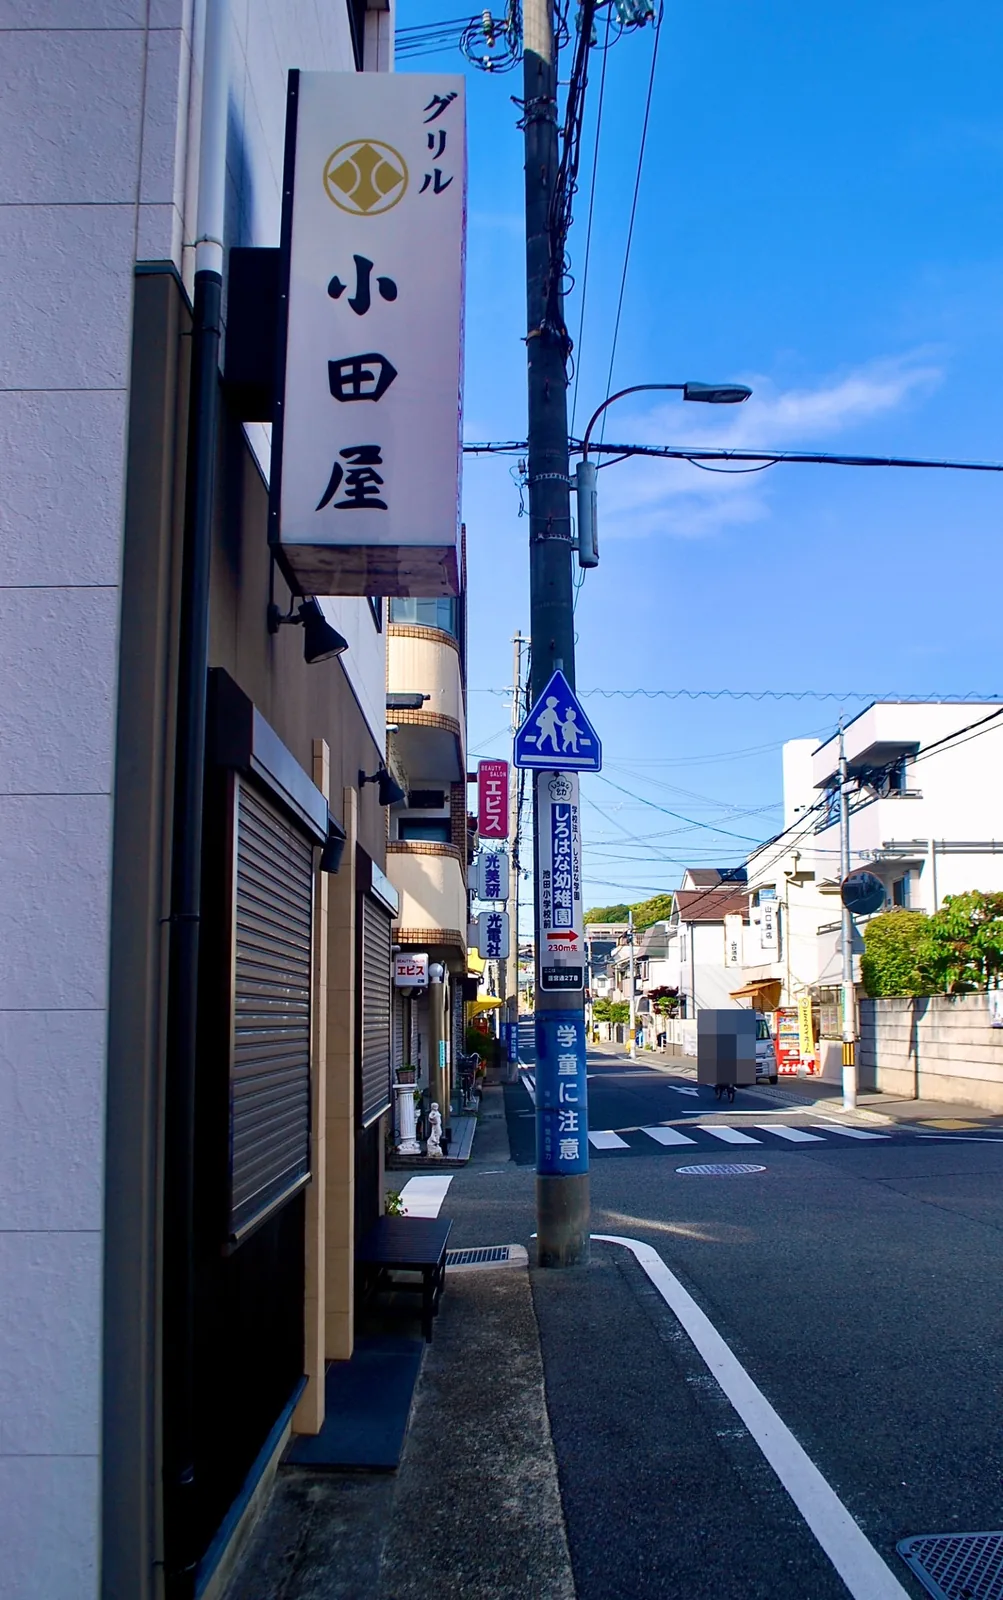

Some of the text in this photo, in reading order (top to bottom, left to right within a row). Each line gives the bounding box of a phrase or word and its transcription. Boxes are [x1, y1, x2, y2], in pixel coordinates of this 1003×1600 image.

[418, 91, 458, 195] グリル
[314, 253, 398, 512] 小田屋
[485, 780, 502, 831] エビス
[485, 854, 501, 898] 光美研
[553, 805, 572, 926] しろはな幼稚園
[543, 870, 552, 929] 池田小学校前
[486, 913, 503, 957] 光電社
[548, 944, 578, 952] 230m先
[397, 965, 425, 976] エビス
[557, 1025, 580, 1160] 学童に注意
